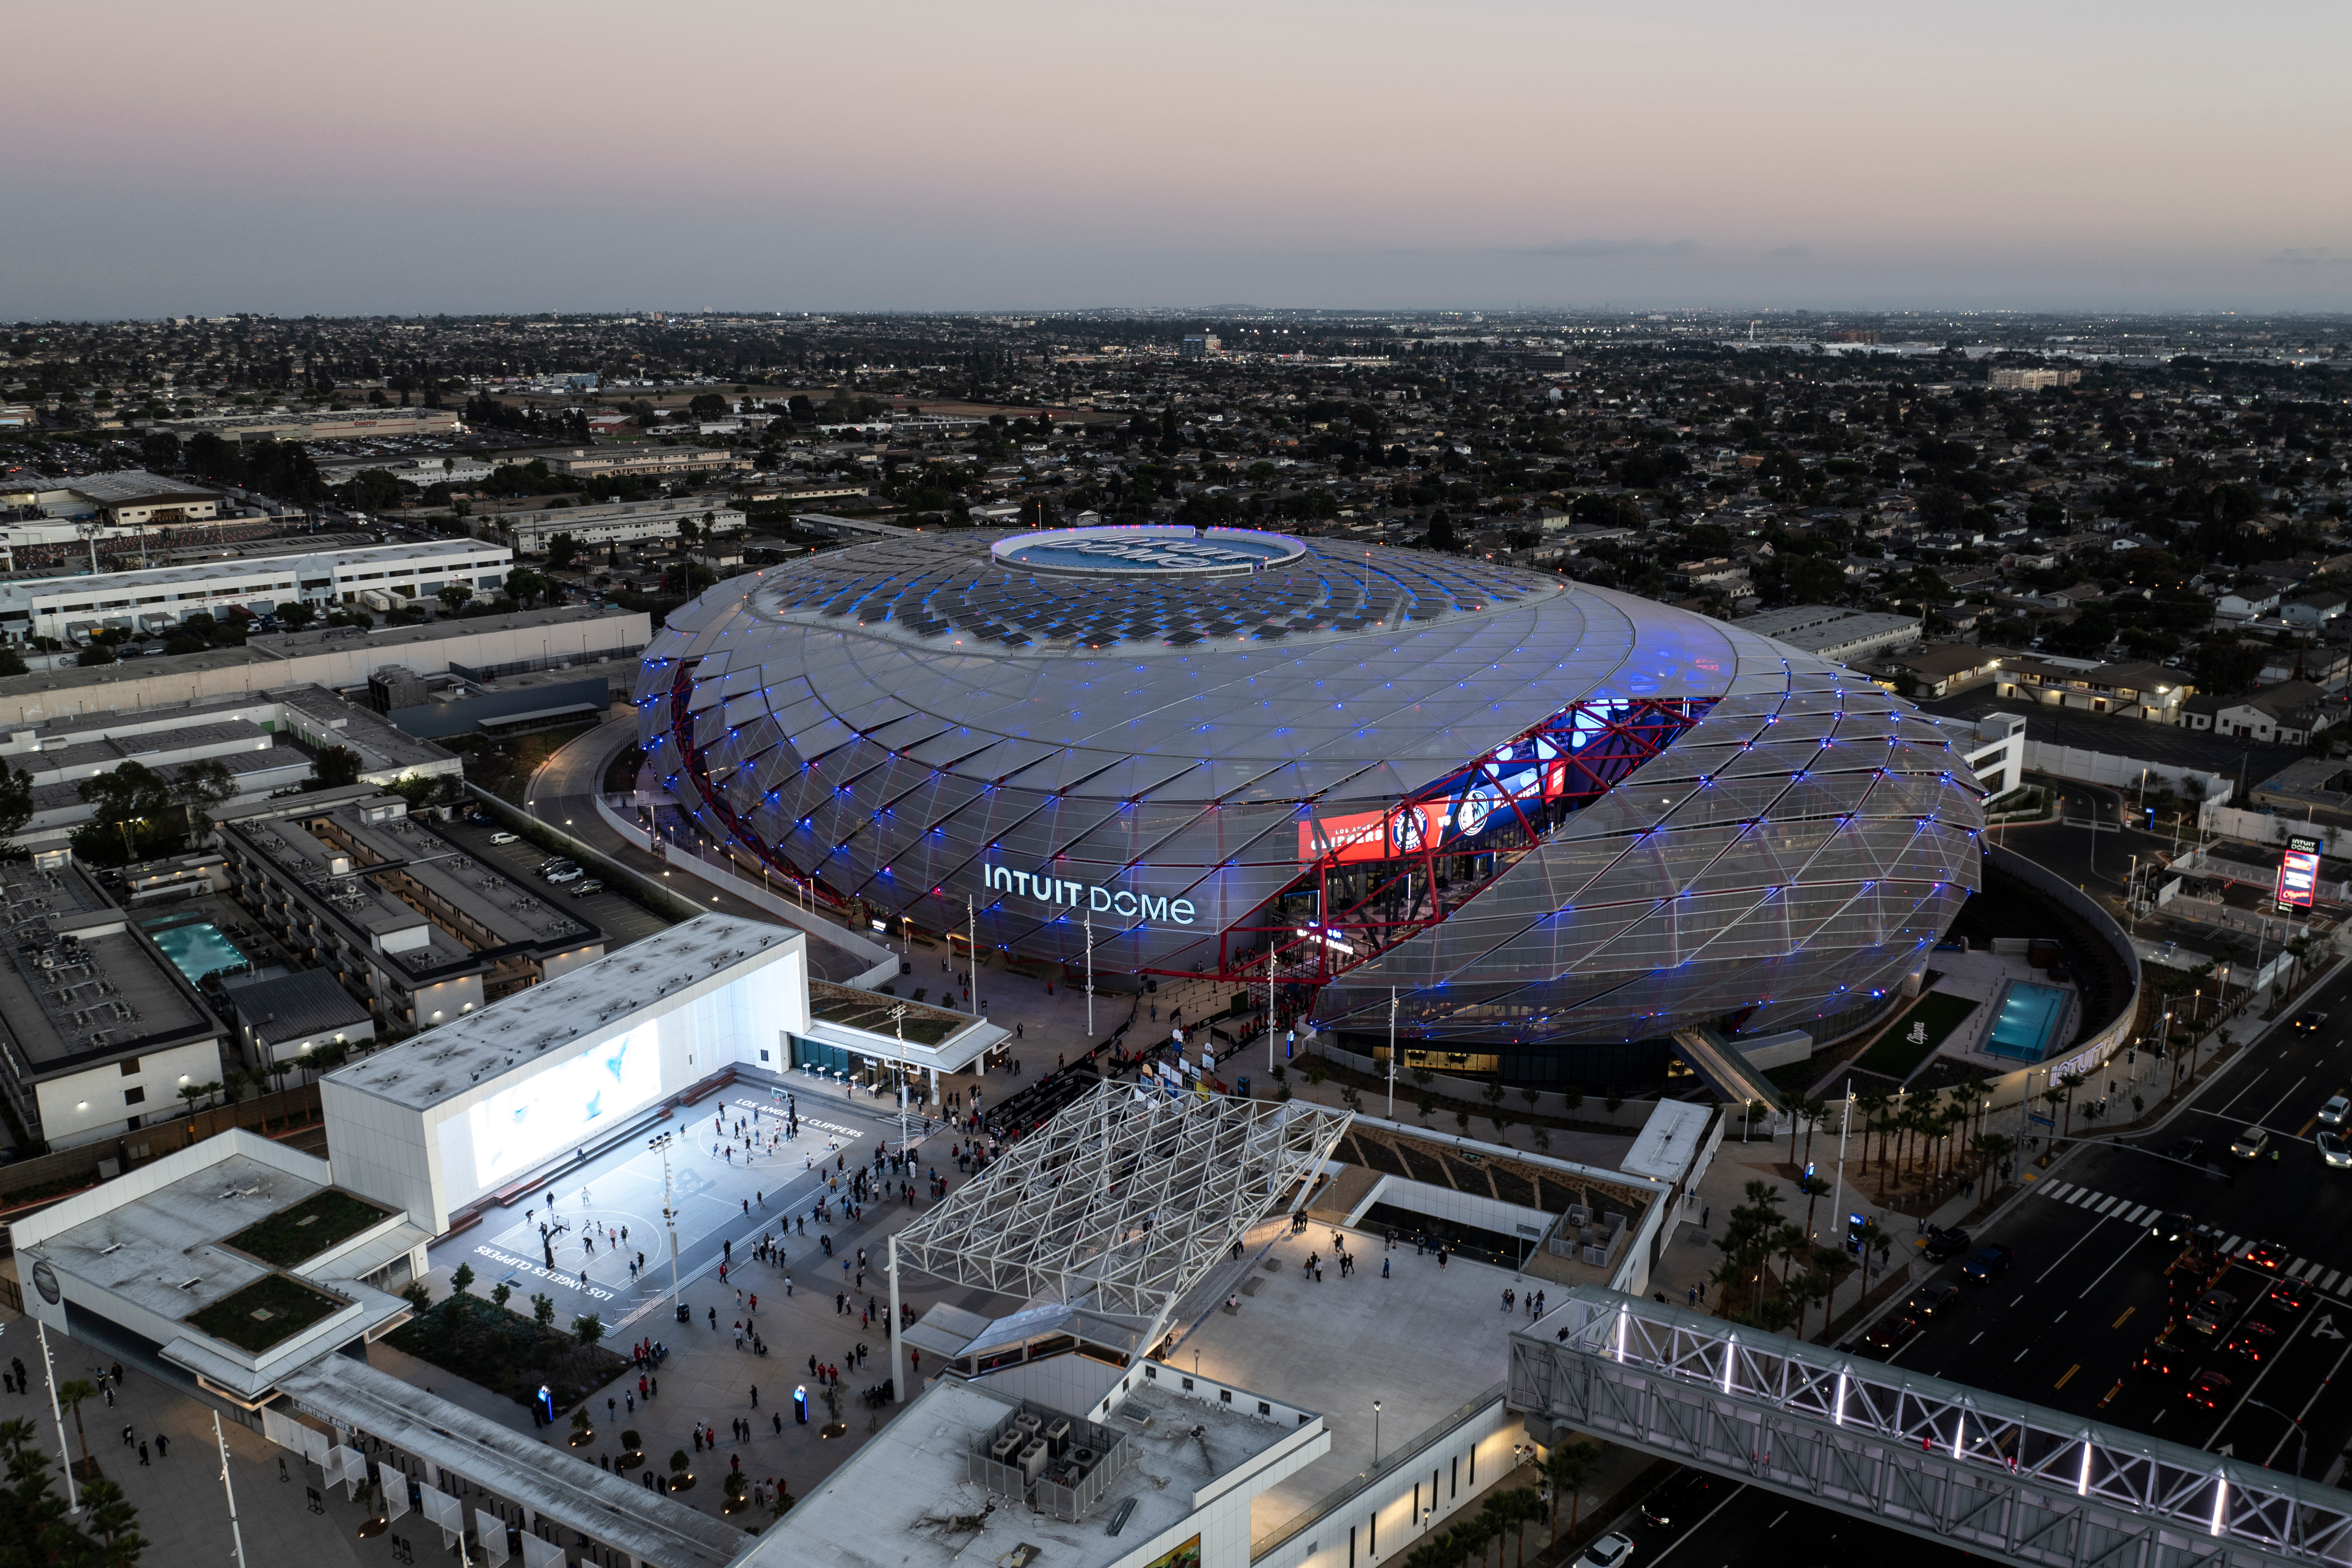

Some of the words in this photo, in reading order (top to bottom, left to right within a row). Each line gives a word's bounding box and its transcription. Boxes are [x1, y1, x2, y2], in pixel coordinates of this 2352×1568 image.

[1437, 815, 1451, 827] VS
[2292, 838, 2316, 848] INTUIT
[985, 863, 1083, 907] INTUIT
[1297, 929, 1315, 941] MAN
[1316, 935, 1354, 955] ETRANCE
[1907, 1022, 1928, 1044] Clippers
[863, 1057, 877, 1067] Modelo
[735, 1098, 759, 1108] LOS
[808, 1119, 864, 1138] CLIPPERS
[474, 1245, 533, 1270] CLIPPERS
[586, 1287, 615, 1301] LOS
[298, 1402, 330, 1423] CENTURY
[331, 1418, 350, 1432] GATE
